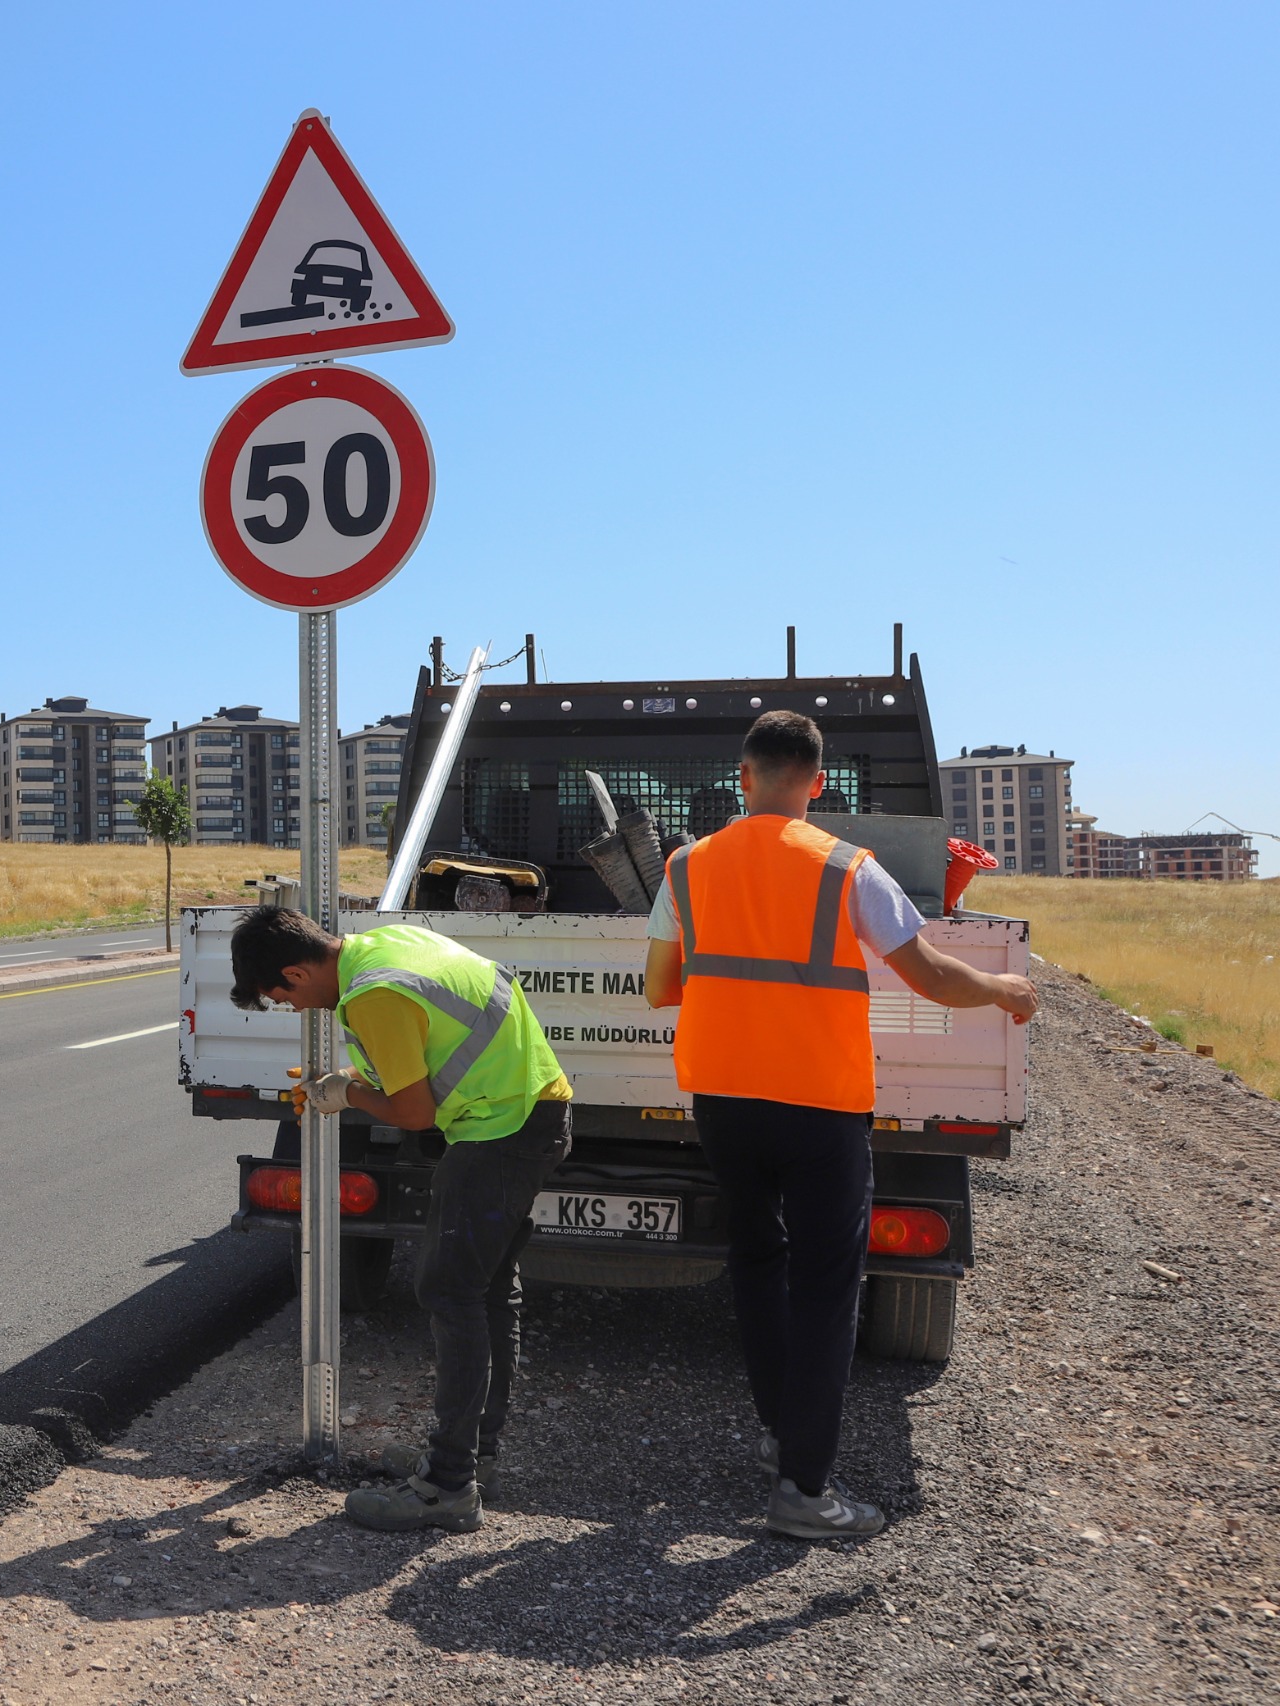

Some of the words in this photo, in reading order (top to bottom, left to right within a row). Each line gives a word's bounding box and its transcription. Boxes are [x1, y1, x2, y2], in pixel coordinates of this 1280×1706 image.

[243, 432, 391, 544] 50
[513, 967, 594, 994] ZMETE
[581, 1025, 675, 1045] MÜDÜRLÜ
[558, 1196, 606, 1228] KKS
[627, 1200, 676, 1232] 357
[540, 1226, 624, 1238] www.otokoc.com.tr
